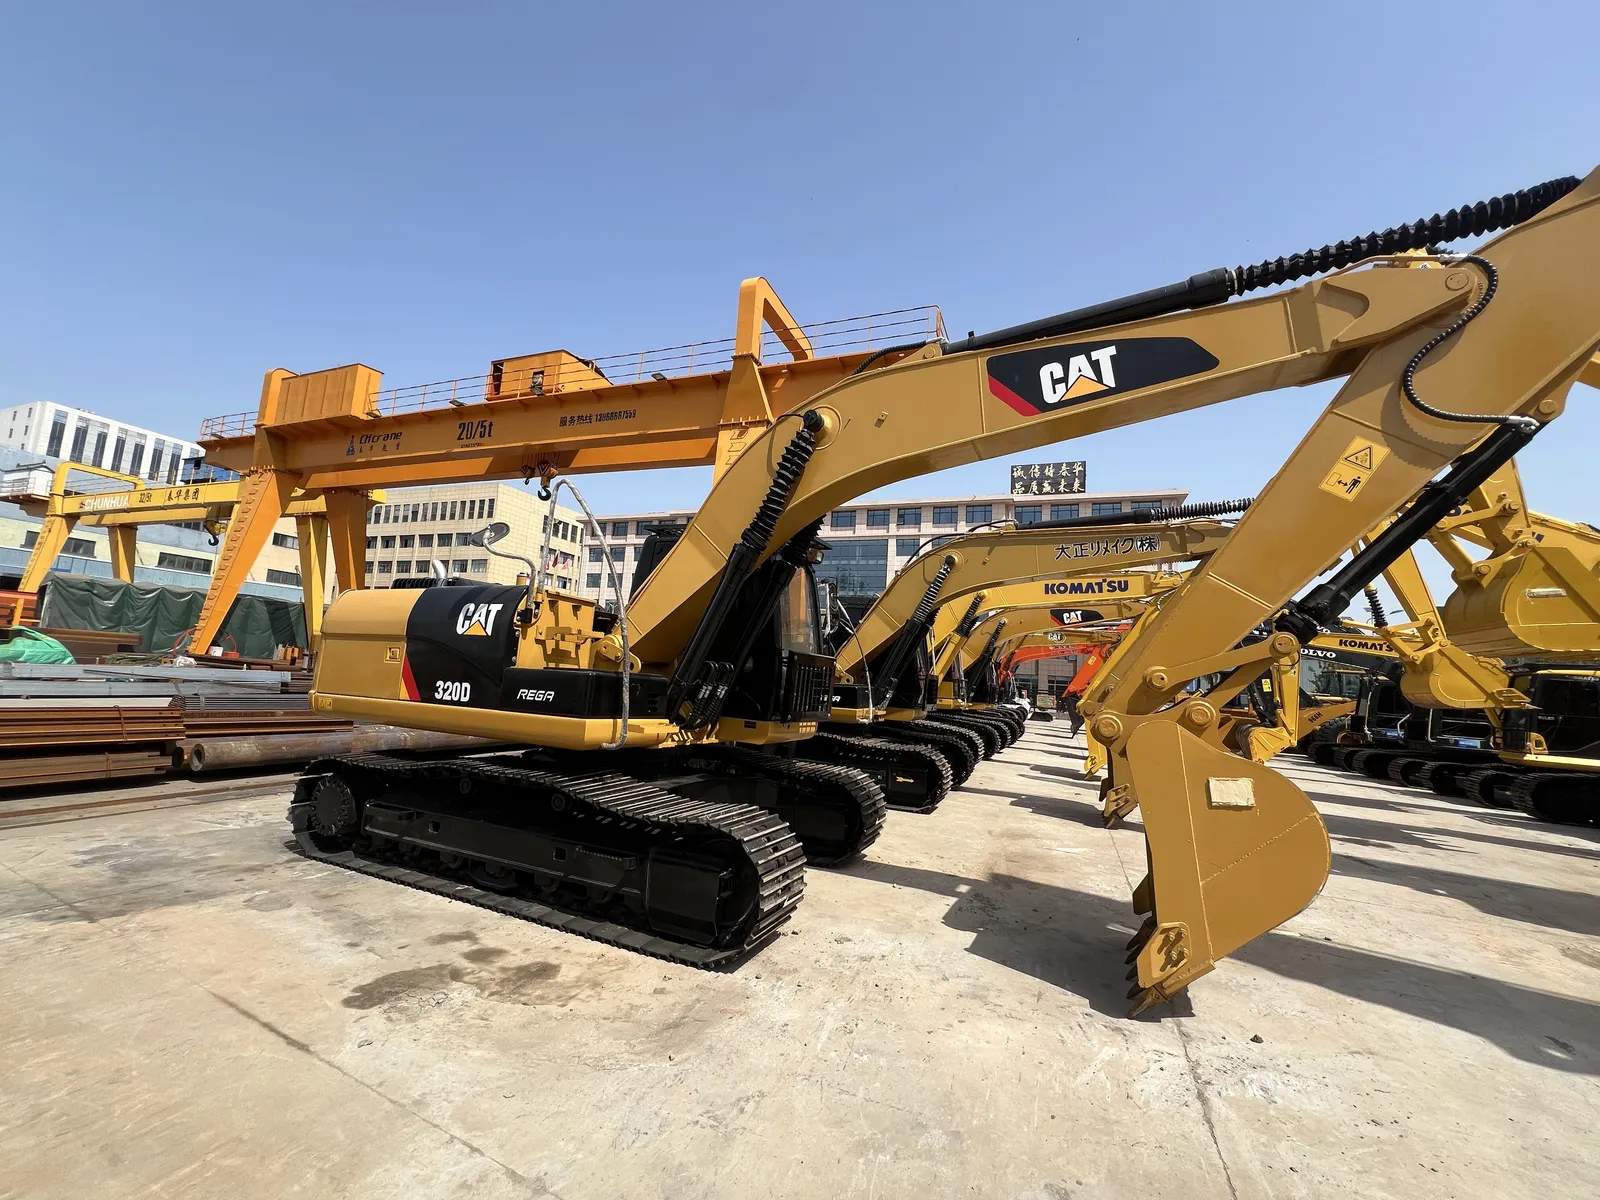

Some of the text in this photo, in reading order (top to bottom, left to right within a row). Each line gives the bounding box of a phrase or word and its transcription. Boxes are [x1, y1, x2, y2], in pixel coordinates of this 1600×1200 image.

[1039, 345, 1117, 404] CAT
[456, 419, 493, 441] 20/5t
[84, 495, 129, 511] CHUNHUA
[1044, 578, 1129, 595] KOMATSU
[455, 602, 504, 637] CAT
[1063, 610, 1083, 624] CAT
[1338, 638, 1394, 652] KOMATS
[1300, 648, 1337, 659] OLVO
[434, 680, 471, 703] 320D
[516, 688, 555, 703] REGA
